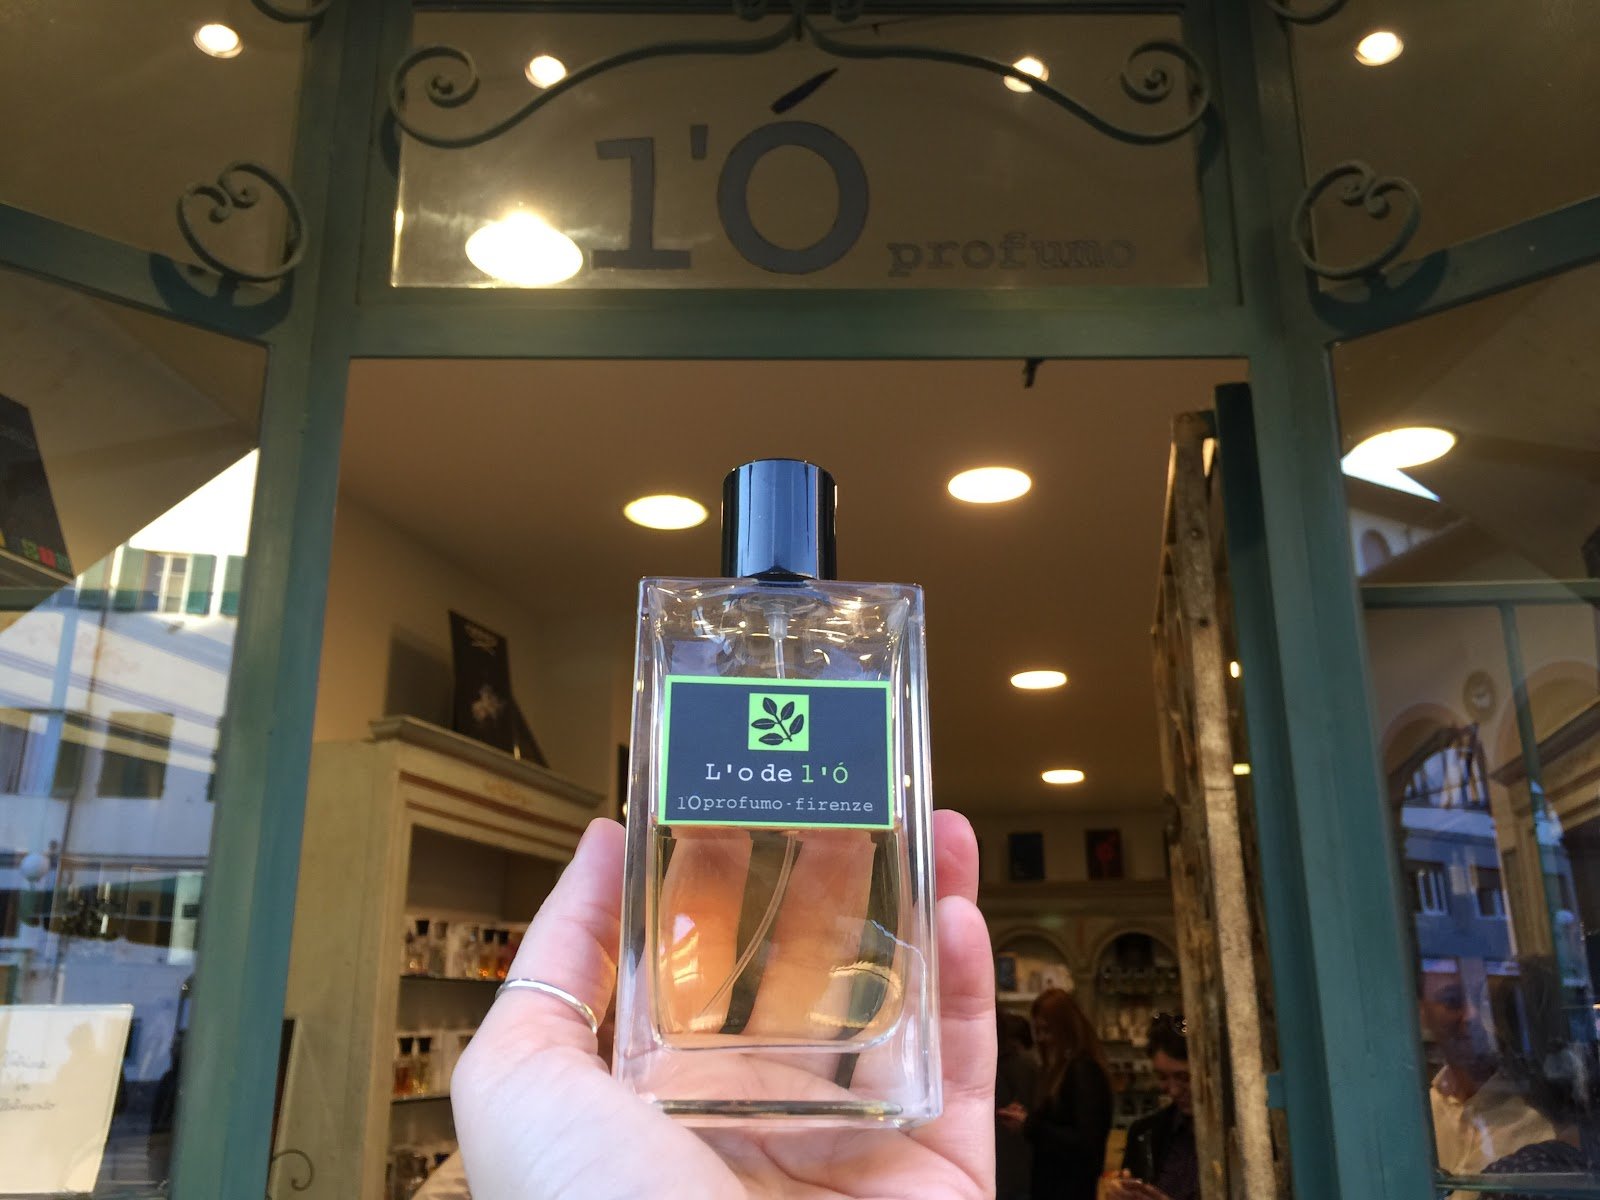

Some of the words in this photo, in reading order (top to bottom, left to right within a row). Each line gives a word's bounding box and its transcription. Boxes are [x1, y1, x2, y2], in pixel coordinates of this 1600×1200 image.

[886, 231, 1136, 277] profumo
[705, 763, 753, 782] L'o
[760, 764, 792, 782] de
